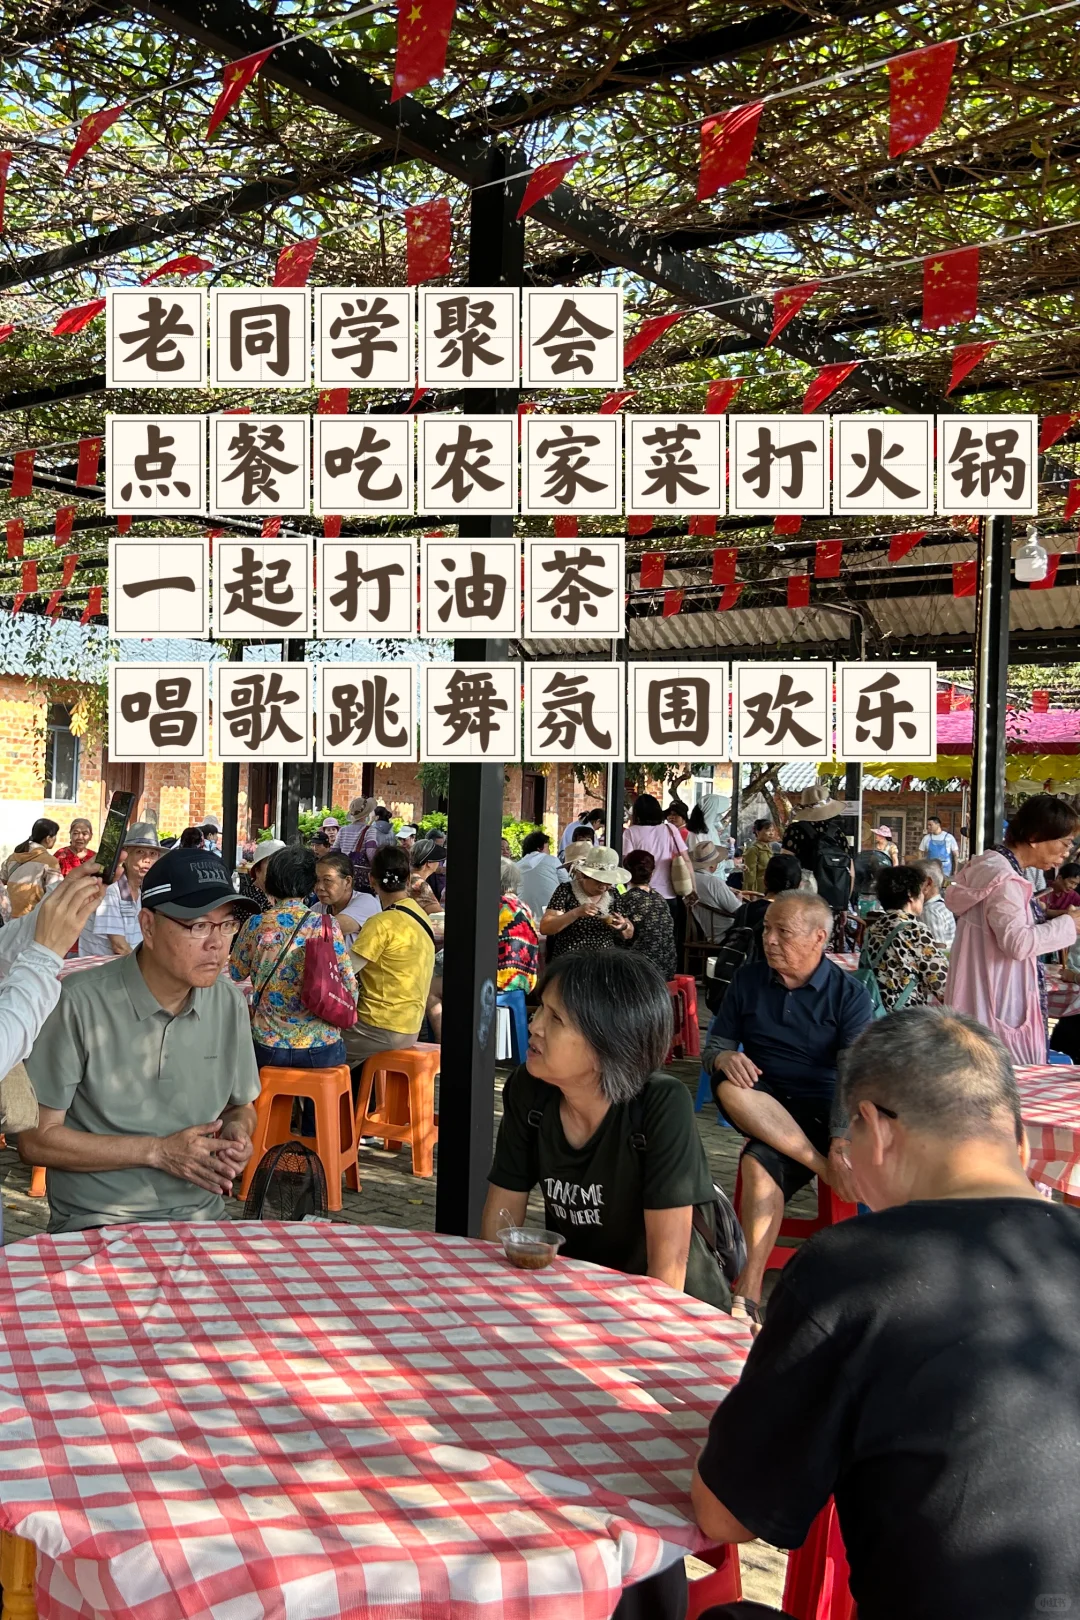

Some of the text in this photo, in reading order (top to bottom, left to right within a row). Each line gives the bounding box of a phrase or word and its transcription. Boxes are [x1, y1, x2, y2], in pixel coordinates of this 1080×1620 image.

[544, 1178, 606, 1206] TAKE ME
[550, 1203, 604, 1226] TO HERE
